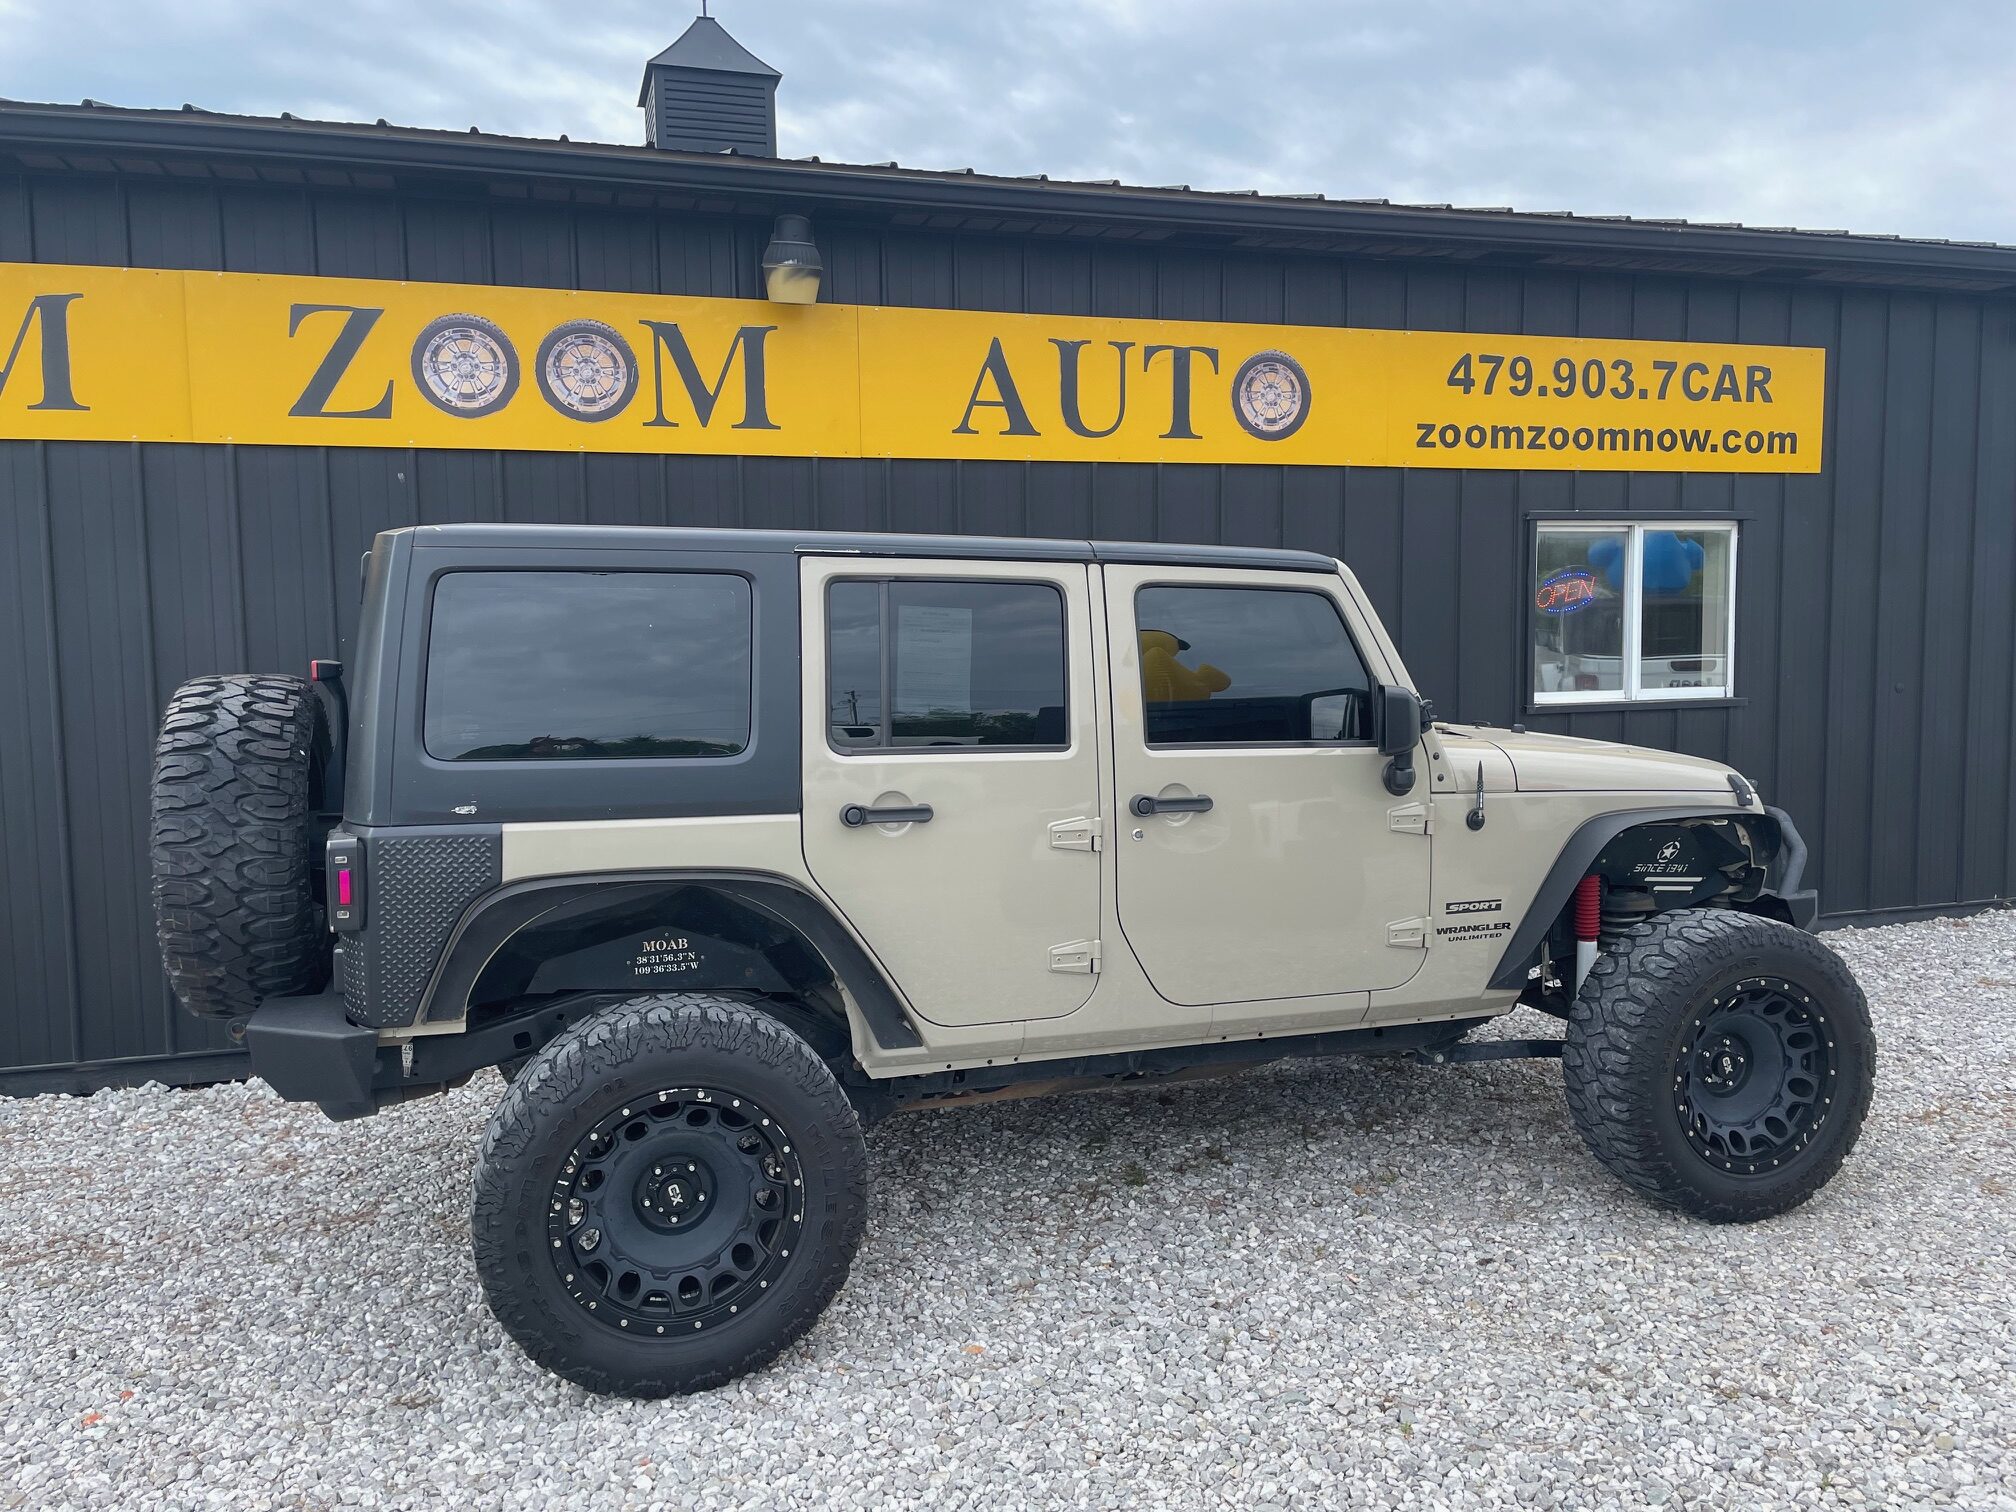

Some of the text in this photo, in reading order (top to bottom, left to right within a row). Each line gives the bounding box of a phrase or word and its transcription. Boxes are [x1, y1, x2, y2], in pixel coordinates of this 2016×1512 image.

[288, 303, 782, 431] ZOOM
[952, 336, 1313, 442] AUTO
[1446, 352, 1775, 404] 479.903.7CAR
[1416, 423, 1799, 455] zoomzoomnow.com
[1536, 576, 1597, 608] OPEN
[1448, 901, 1499, 912] SPORT
[1436, 922, 1512, 935] WRANGLER
[1448, 932, 1503, 942] UNLIMITED
[642, 938, 688, 952] MOAB
